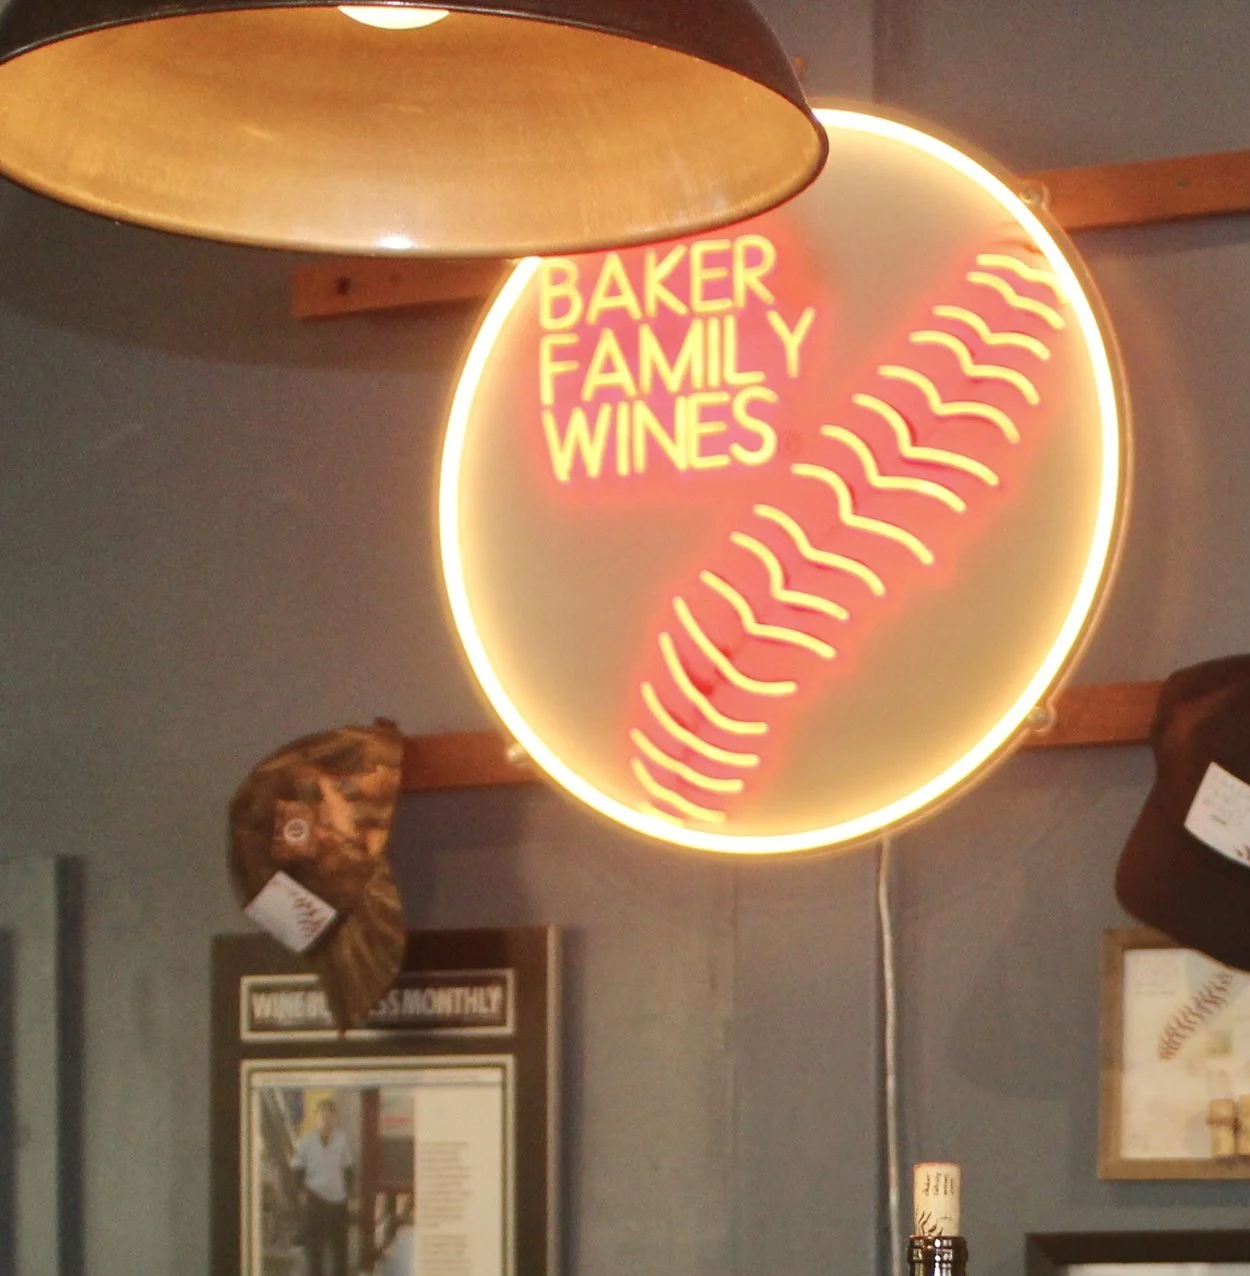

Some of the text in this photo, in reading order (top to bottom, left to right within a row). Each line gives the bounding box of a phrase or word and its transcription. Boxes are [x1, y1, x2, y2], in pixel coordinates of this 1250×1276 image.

[539, 234, 777, 330] BAKER
[539, 307, 815, 406] FAMILY
[541, 385, 779, 483] WINES
